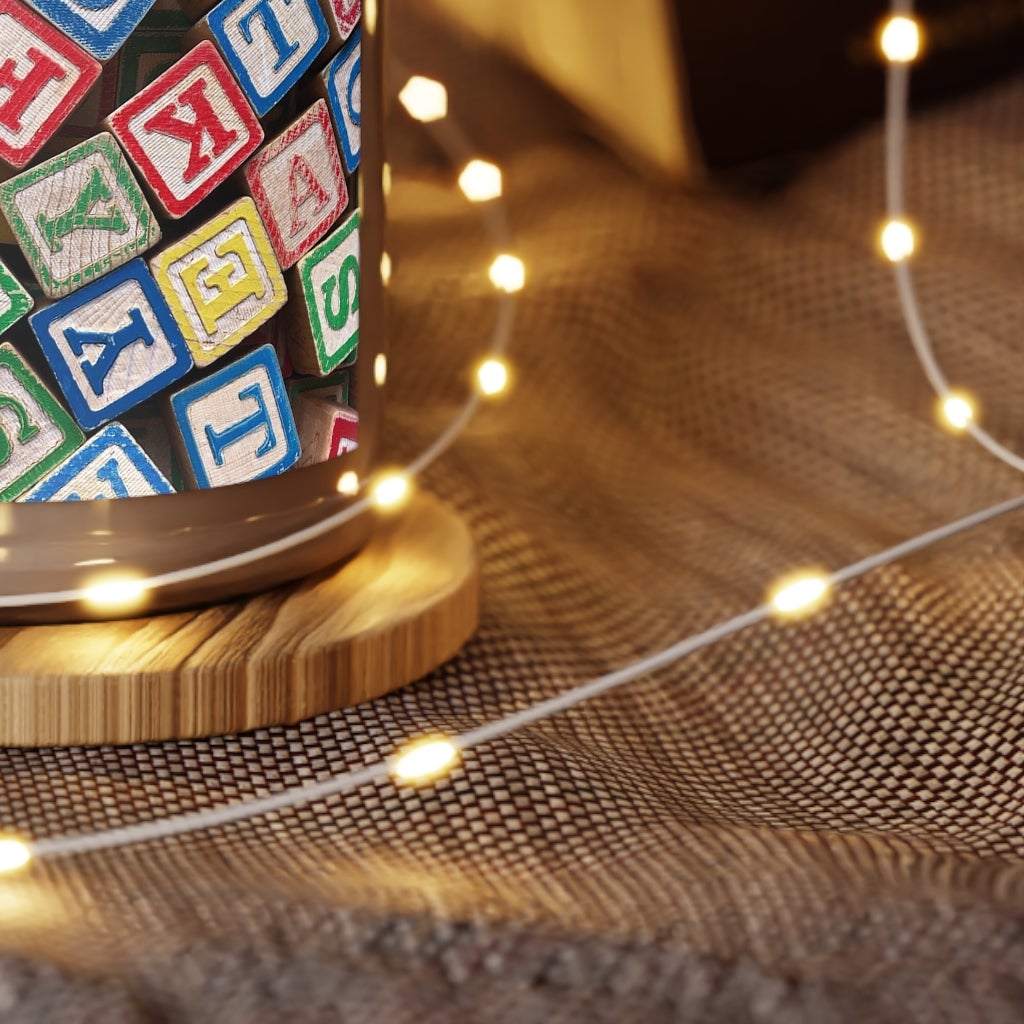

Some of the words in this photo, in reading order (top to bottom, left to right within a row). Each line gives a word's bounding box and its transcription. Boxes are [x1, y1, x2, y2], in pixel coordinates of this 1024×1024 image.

[144, 78, 238, 183] K
[36, 166, 129, 254] Y
[290, 154, 331, 238] A
[180, 232, 265, 335] E
[321, 254, 360, 331] S
[63, 307, 154, 396] Y
[205, 383, 276, 466] T
